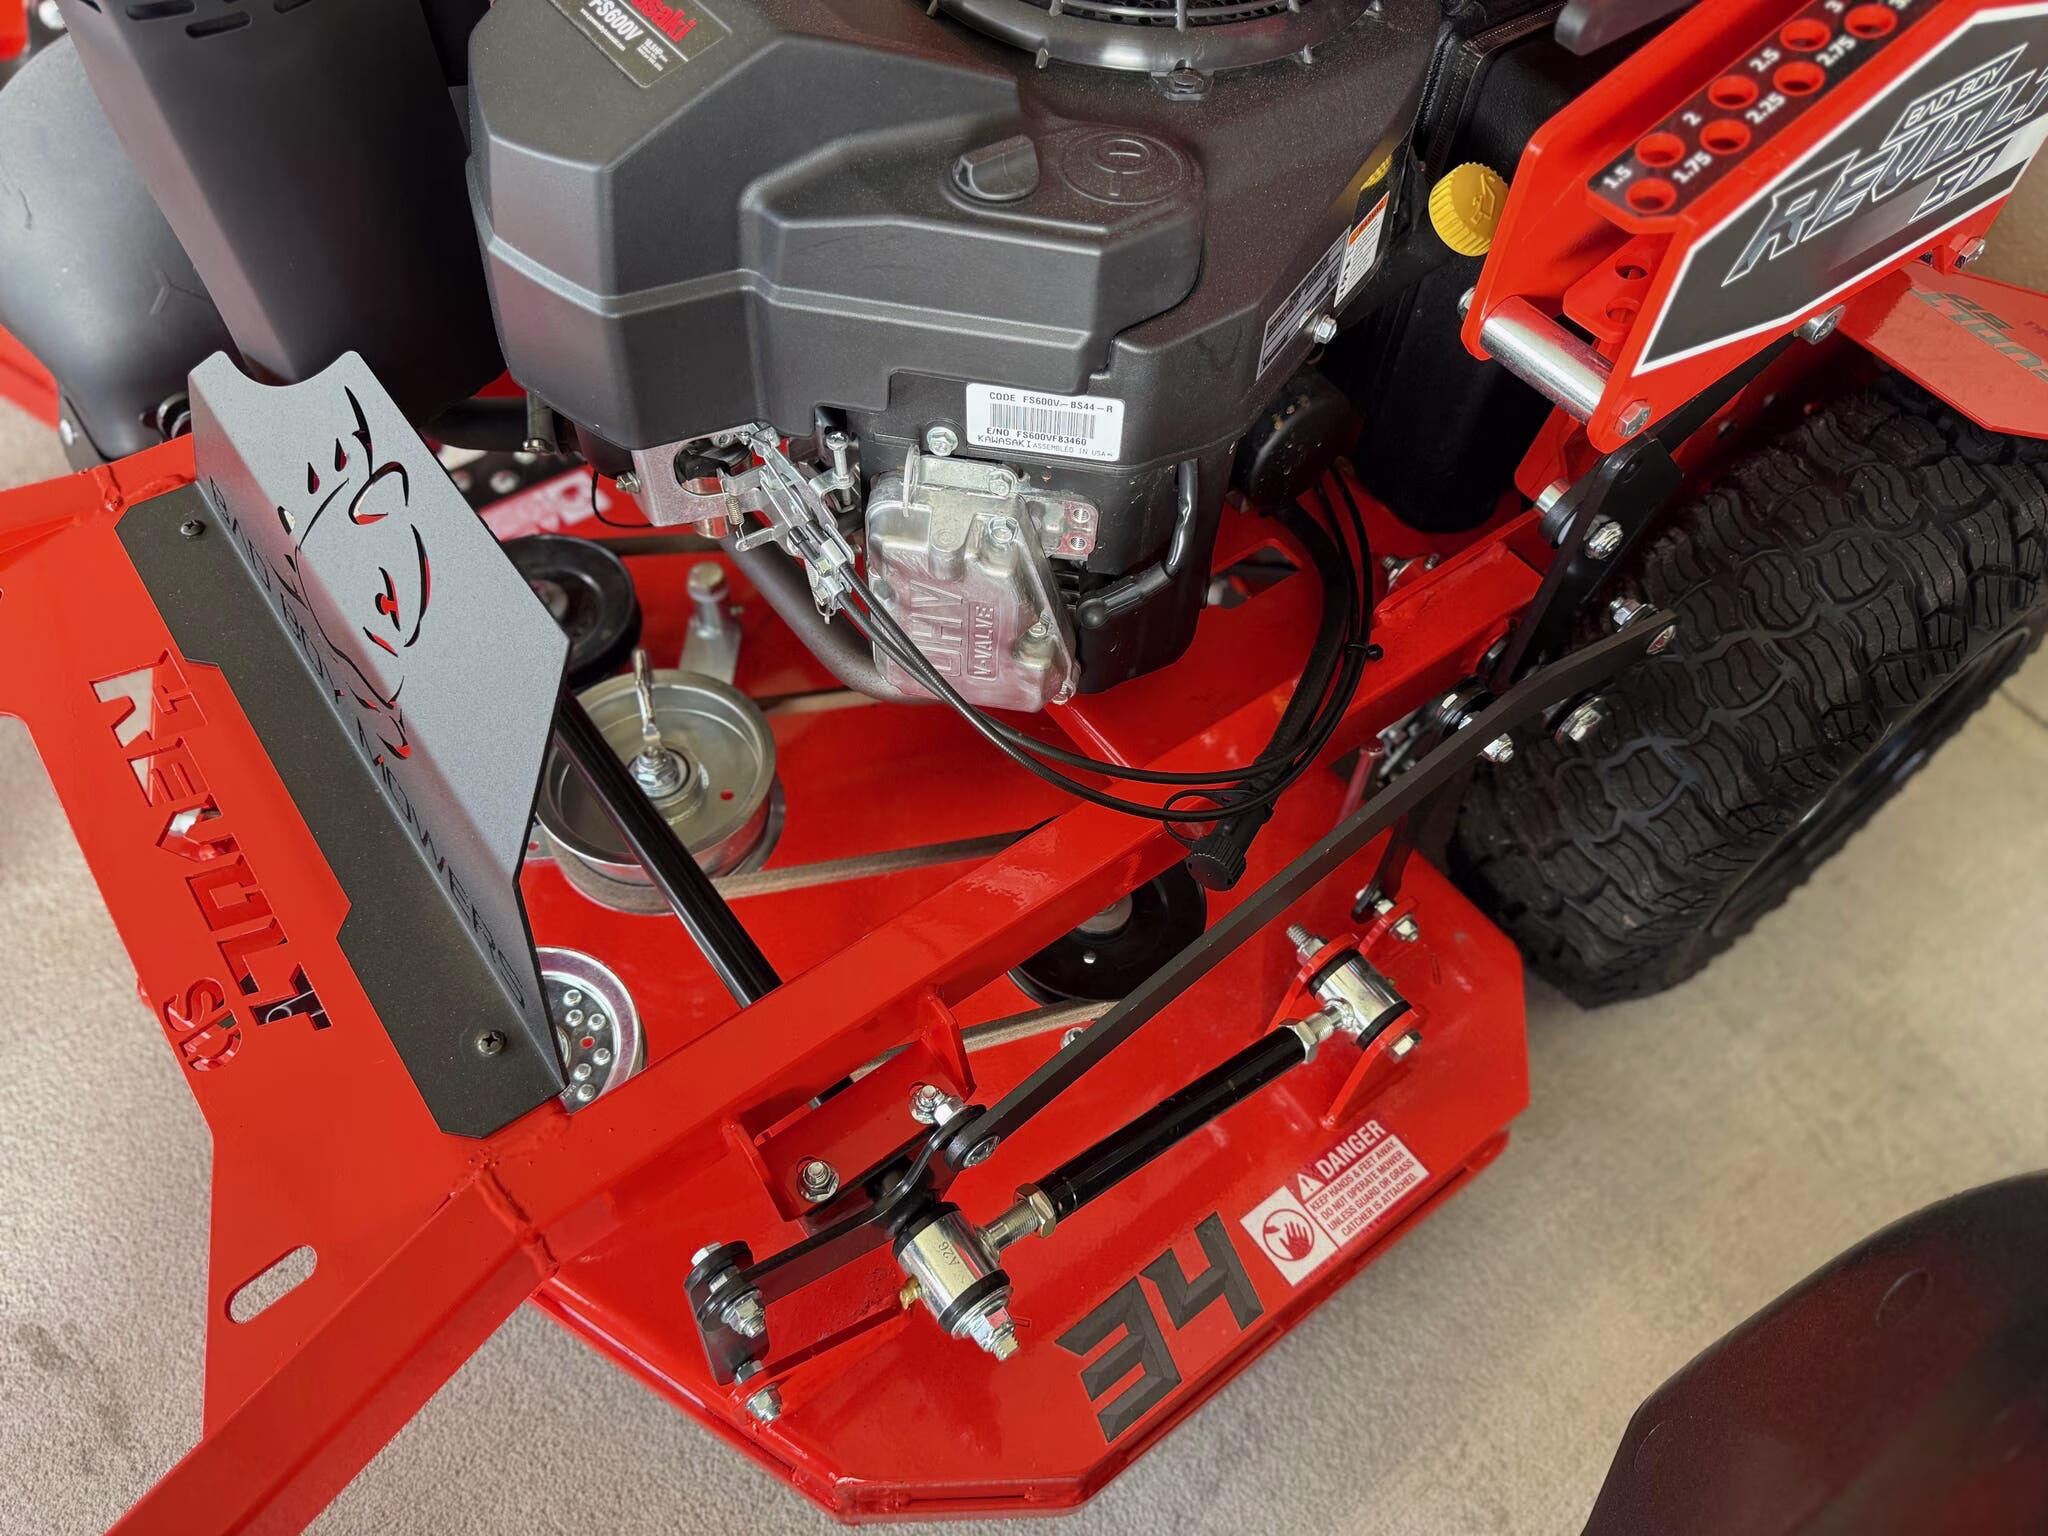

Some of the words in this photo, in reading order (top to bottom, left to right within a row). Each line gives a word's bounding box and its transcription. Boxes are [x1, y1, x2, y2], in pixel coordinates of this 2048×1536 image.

[1749, 48, 1782, 73] 2.5
[1815, 35, 1857, 67] 2.75
[1682, 112, 1703, 127] 2
[1745, 93, 1787, 125] 2.25
[1904, 91, 1952, 129] BAD
[1956, 61, 2009, 102] BOY
[1602, 165, 1633, 190] 1.5
[1672, 151, 1713, 184] 1.75
[989, 391, 1016, 402] CODE
[977, 434, 1031, 448] KAWASAKI
[1032, 442, 1074, 454] ASSEMBLED
[1079, 447, 1088, 455] IN
[1091, 449, 1106, 457] USA
[986, 427, 1010, 437] E/NO
[1016, 430, 1087, 446] FS600VF83460
[210, 475, 271, 593] BAD
[280, 592, 345, 705] BOY
[356, 716, 526, 1009] MOWERS
[89, 648, 333, 1030] REVOLT
[163, 977, 243, 1072] SD
[1315, 1119, 1387, 1179] DANGER
[1310, 1193, 1329, 1211] KEEP
[1329, 1174, 1354, 1198] HANDS
[1359, 1156, 1378, 1173] FEET
[1320, 1207, 1334, 1221] DO
[1333, 1194, 1349, 1212] NOT
[1348, 1170, 1379, 1199] OPERATE
[1377, 1151, 1406, 1174] MOWER
[1327, 1207, 1357, 1231] UNLESS
[1356, 1186, 1381, 1209] GUARD
[1379, 1178, 1392, 1190] OR
[1389, 1159, 1415, 1181] GRASS
[1341, 1209, 1374, 1236] CATCHER
[1374, 1201, 1383, 1212] IS
[1382, 1174, 1417, 1204] ATTACHED.
[1054, 1211, 1264, 1443] 34
